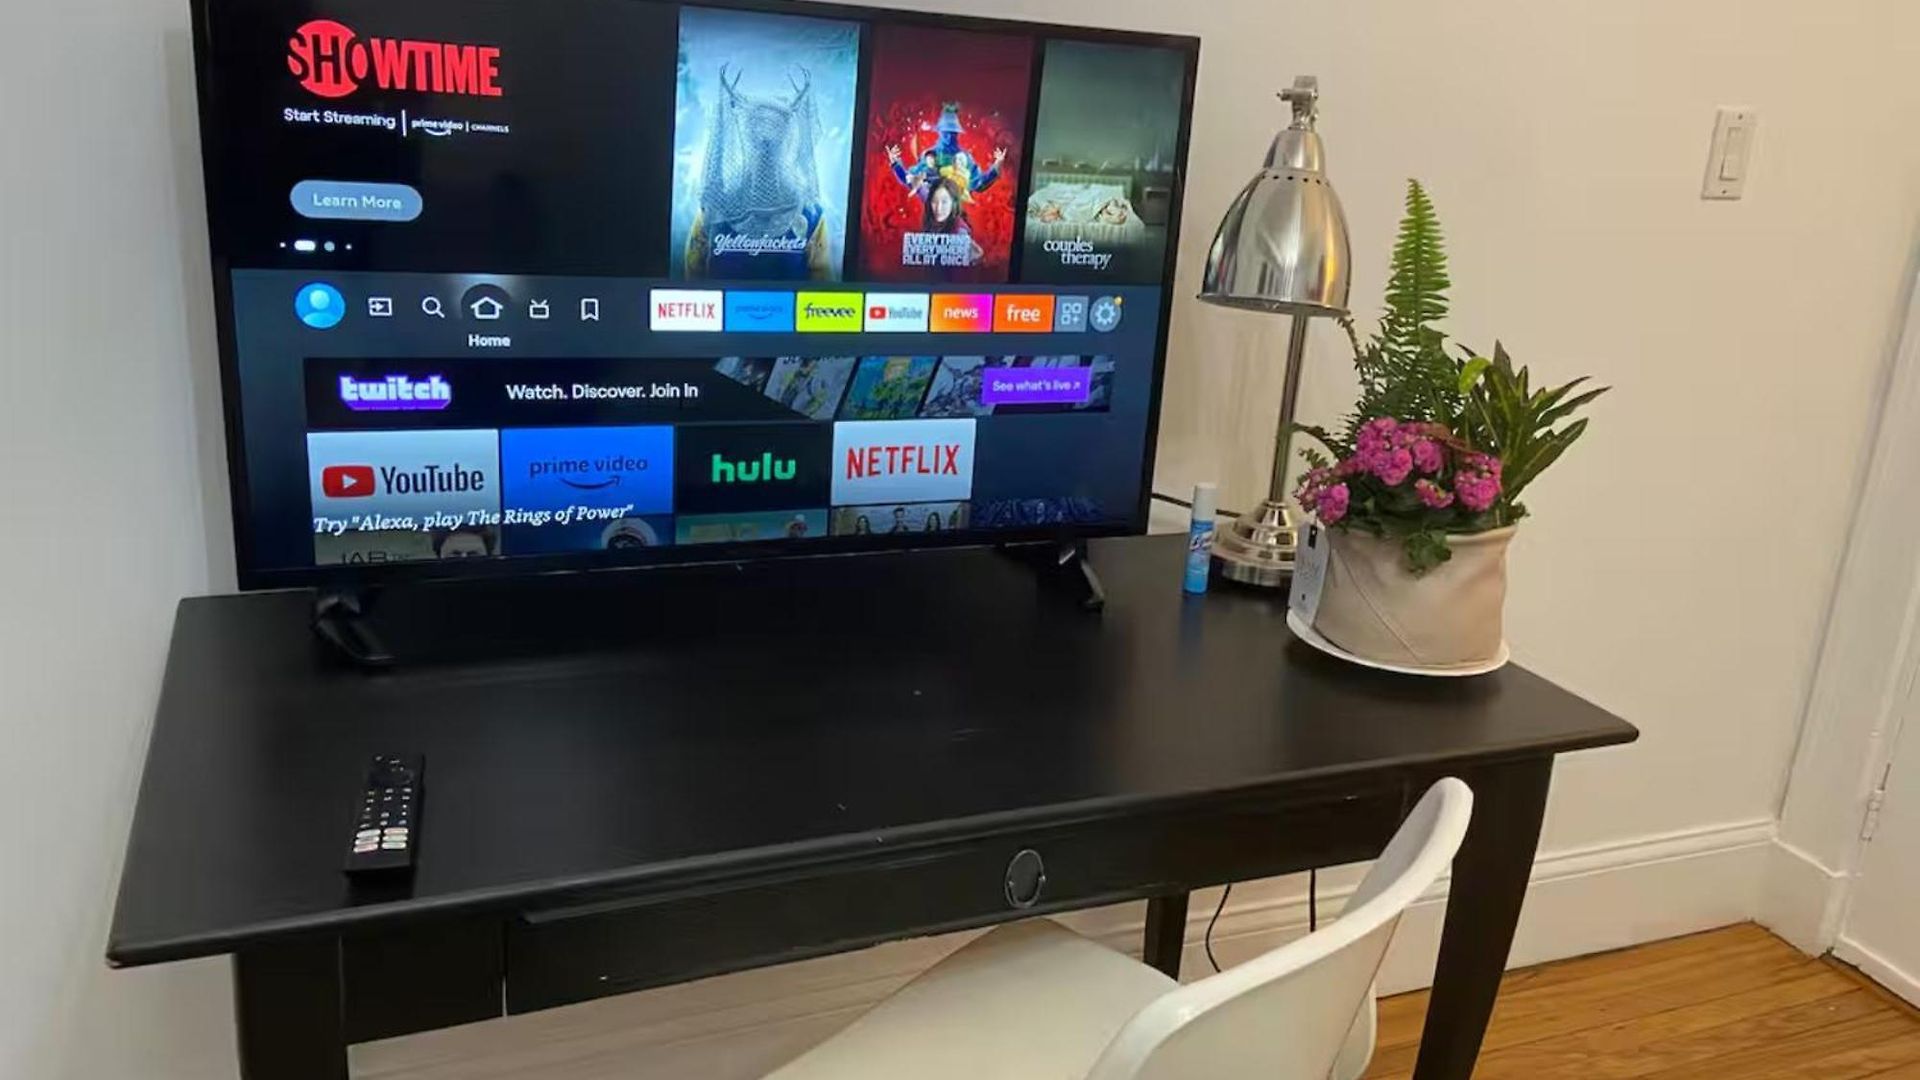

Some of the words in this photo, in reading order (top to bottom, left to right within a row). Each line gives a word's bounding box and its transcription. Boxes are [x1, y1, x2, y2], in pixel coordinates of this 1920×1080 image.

[287, 20, 502, 97] SHOWTIME
[284, 108, 320, 123] Start
[323, 110, 396, 129] Streaming
[470, 124, 509, 133] CHANNELS
[313, 193, 357, 208] Learn
[362, 196, 402, 210] More
[714, 233, 807, 256] Yellowjackets
[1043, 235, 1094, 252] couples
[1061, 252, 1112, 270] therapy
[657, 303, 716, 319] NETFLIX
[804, 303, 855, 319] freevee
[888, 306, 923, 320] YouTube
[943, 307, 978, 319] news
[1006, 304, 1041, 322] free
[468, 334, 511, 347] Home
[339, 374, 452, 410] twitch
[506, 384, 567, 400] Watch.
[572, 382, 646, 398] Discover.
[650, 382, 680, 398] Join
[684, 384, 698, 397] In
[992, 380, 1014, 392] See
[1016, 380, 1051, 391] what's
[1053, 380, 1072, 391] live
[529, 458, 590, 478] prime
[596, 454, 648, 473] video
[712, 452, 796, 483] hulu
[846, 444, 960, 479] NETFLIX
[380, 464, 484, 494] YouTube
[314, 517, 347, 536] Try
[352, 514, 418, 531] "Alexa,
[422, 511, 463, 532] play
[467, 509, 500, 526] The
[502, 508, 552, 526] Rings
[554, 504, 576, 525] of
